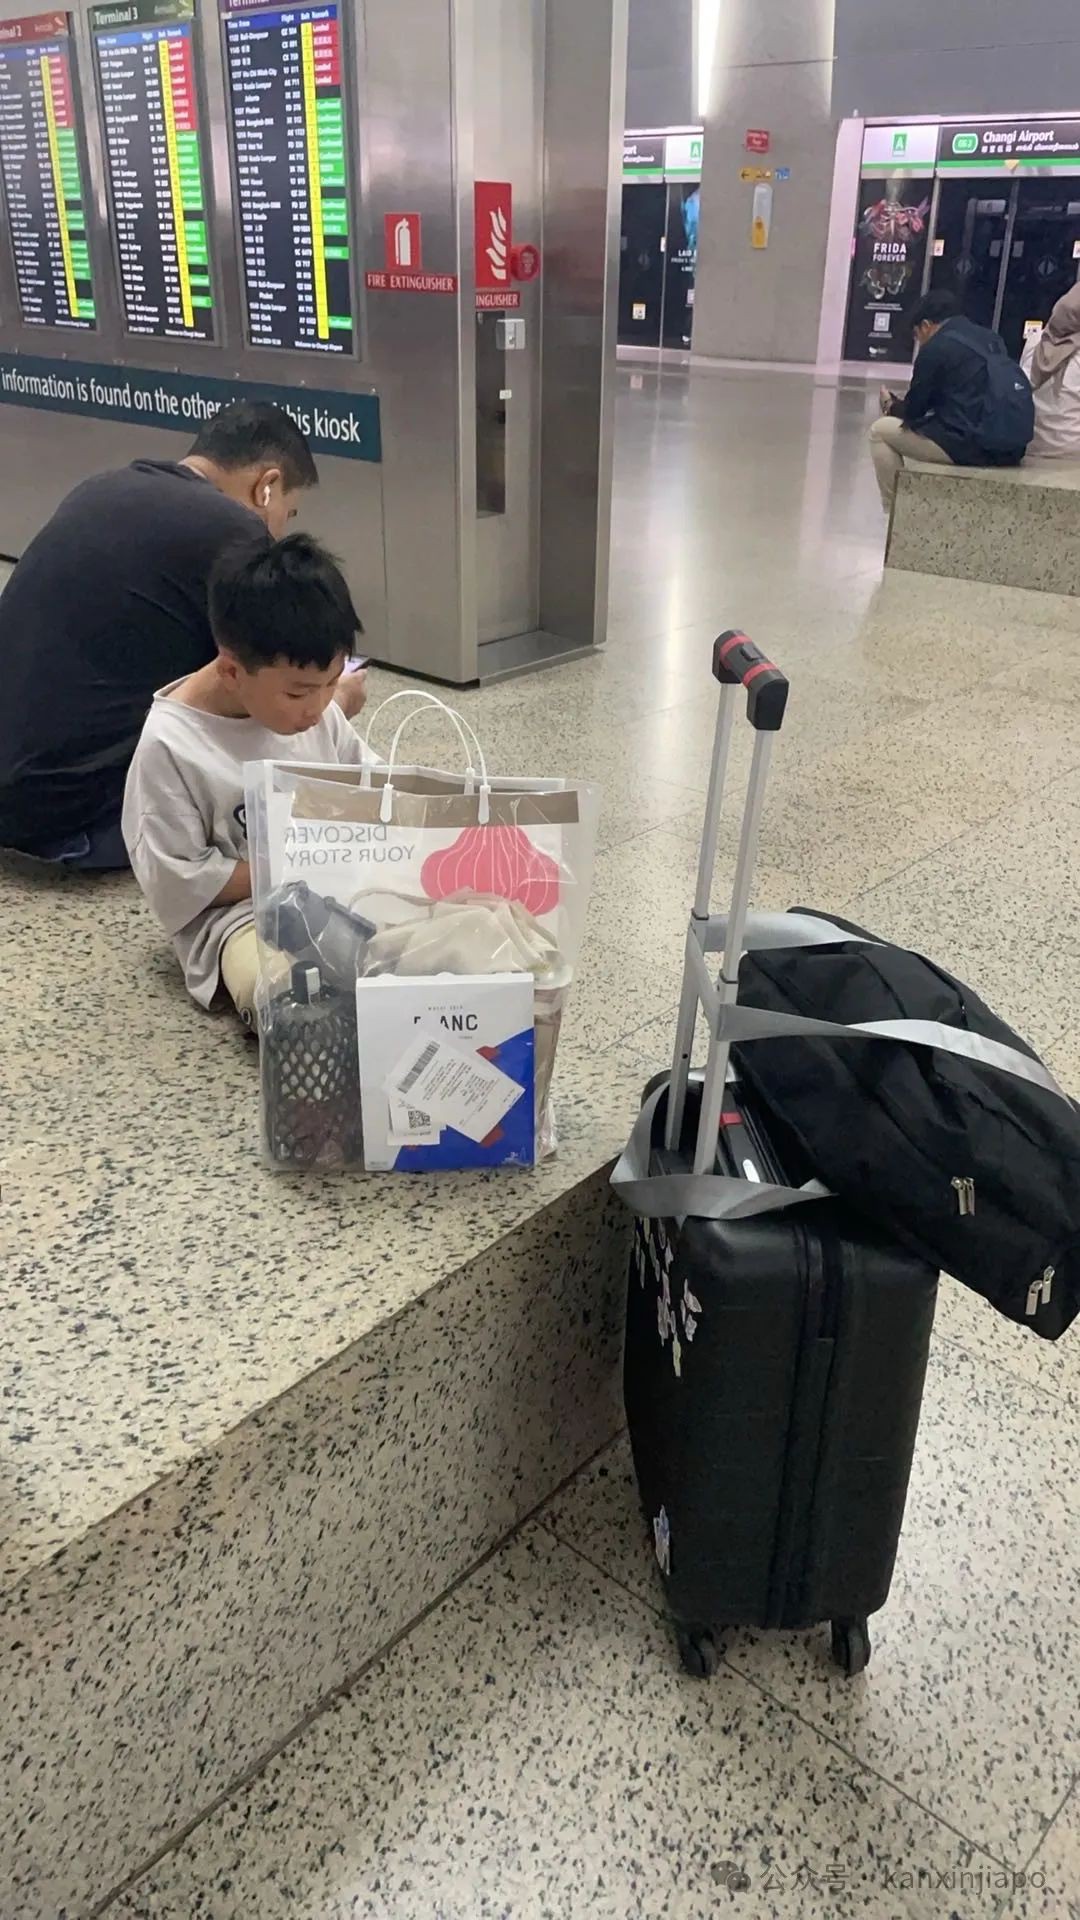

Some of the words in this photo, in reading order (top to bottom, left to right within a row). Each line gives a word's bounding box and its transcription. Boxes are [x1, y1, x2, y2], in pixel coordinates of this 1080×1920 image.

[94, 8, 131, 24] Terminal
[983, 131, 1016, 144] Changi
[1018, 130, 1054, 144] Airport
[873, 243, 906, 254] FRIDA
[872, 254, 906, 262] FOREVER
[368, 274, 386, 287] FIRE
[390, 276, 454, 291] EXTINGUISHER
[1, 367, 74, 400] information
[77, 380, 88, 402] is
[90, 381, 132, 409] found
[134, 390, 153, 411] on
[155, 387, 179, 415] the
[182, 391, 222, 420] other
[314, 407, 360, 443] kiosk
